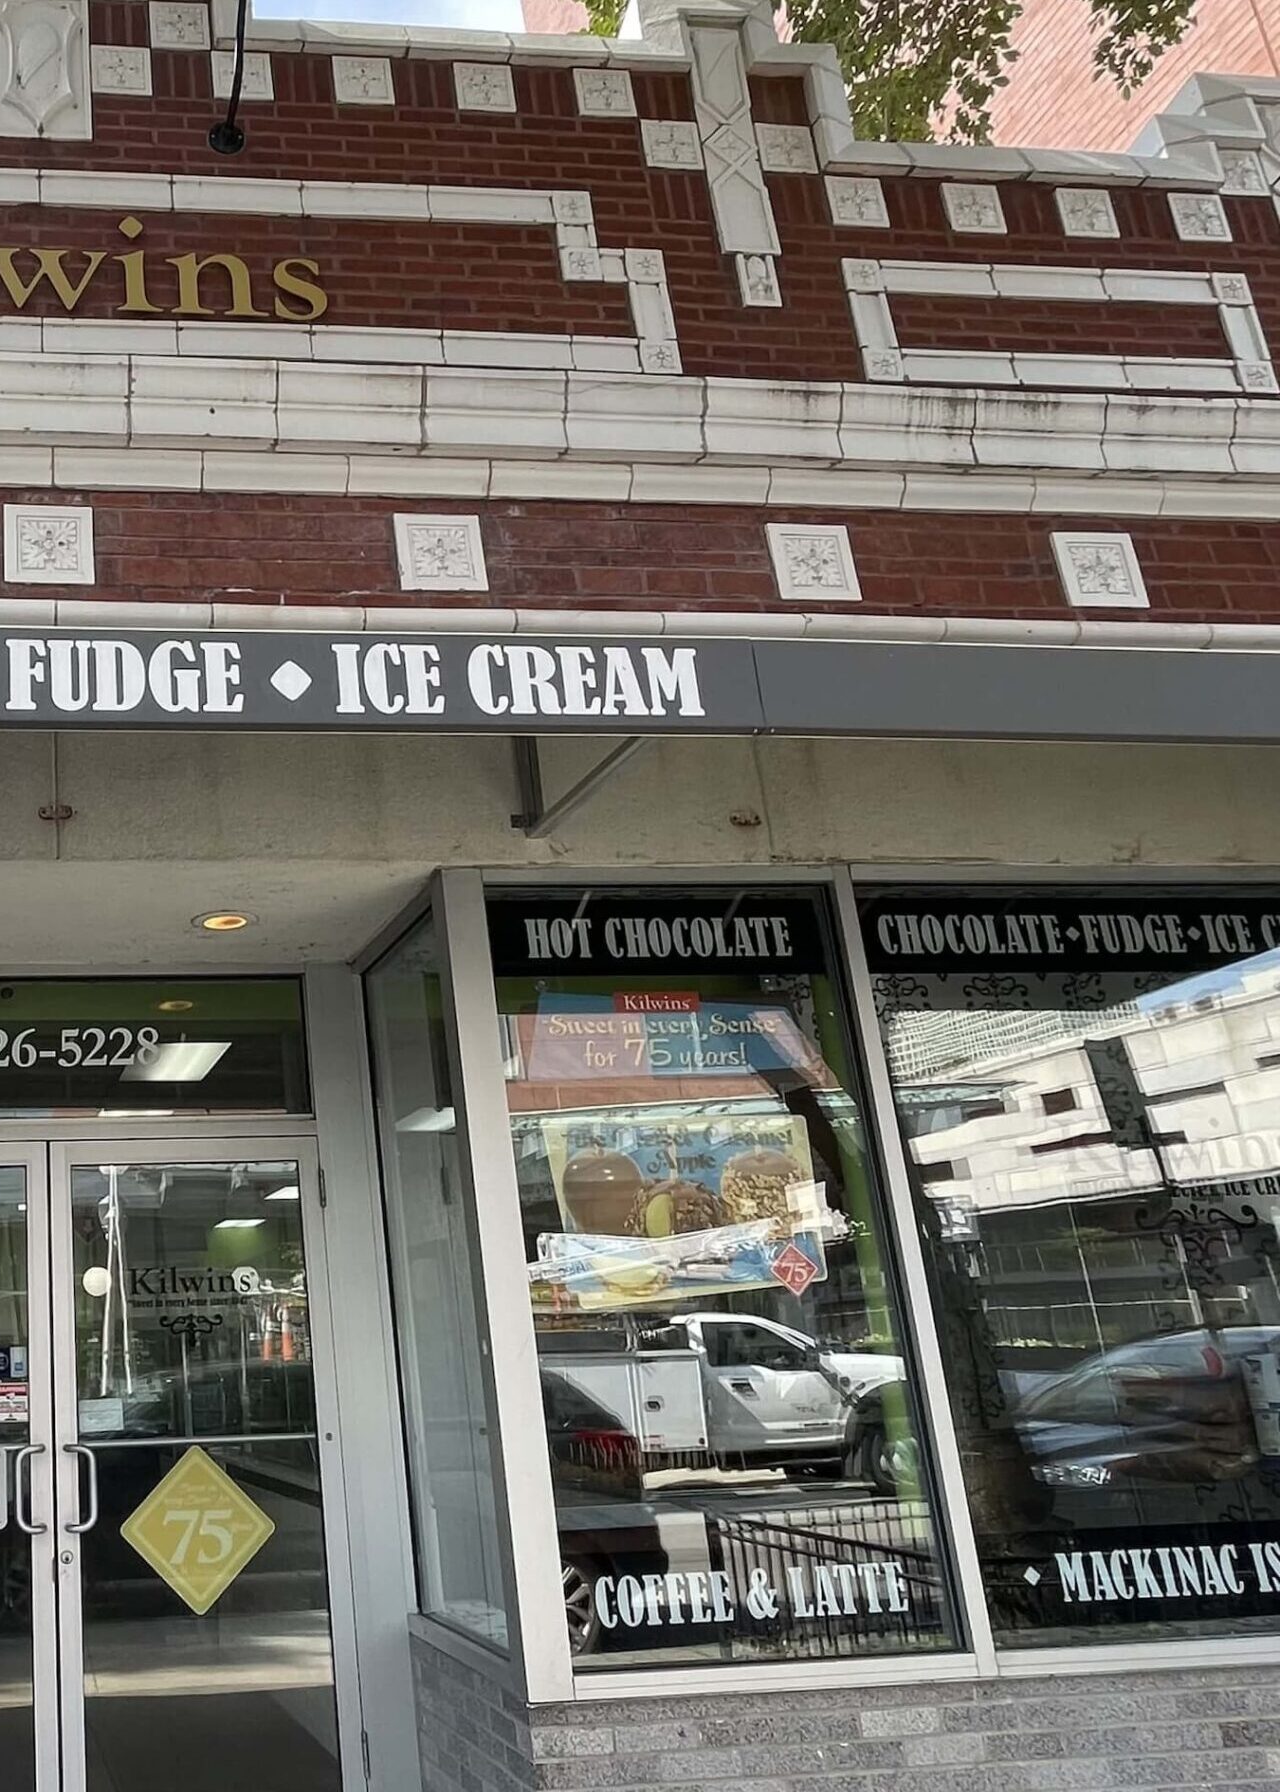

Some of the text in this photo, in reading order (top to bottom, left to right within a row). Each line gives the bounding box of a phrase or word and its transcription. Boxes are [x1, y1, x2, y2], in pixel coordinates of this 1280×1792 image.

[4, 638, 244, 714] FUDGE
[331, 642, 445, 715] ICE
[466, 643, 706, 717] CREAM
[523, 916, 794, 959] HOT CHOCOLATE
[876, 914, 1280, 955] CHOCOLATE FUDGE ICE C
[623, 994, 692, 1011] Kilwins
[622, 1014, 641, 1036] in
[584, 1038, 748, 1074] for 75 years!
[1253, 1174, 1280, 1196] CR
[127, 1266, 251, 1295] Kilwins
[780, 1261, 808, 1283] 75
[162, 1509, 233, 1565] 75
[1053, 1543, 1245, 1603] MACKINAC
[594, 1561, 910, 1629] COFFEE & LATTE
